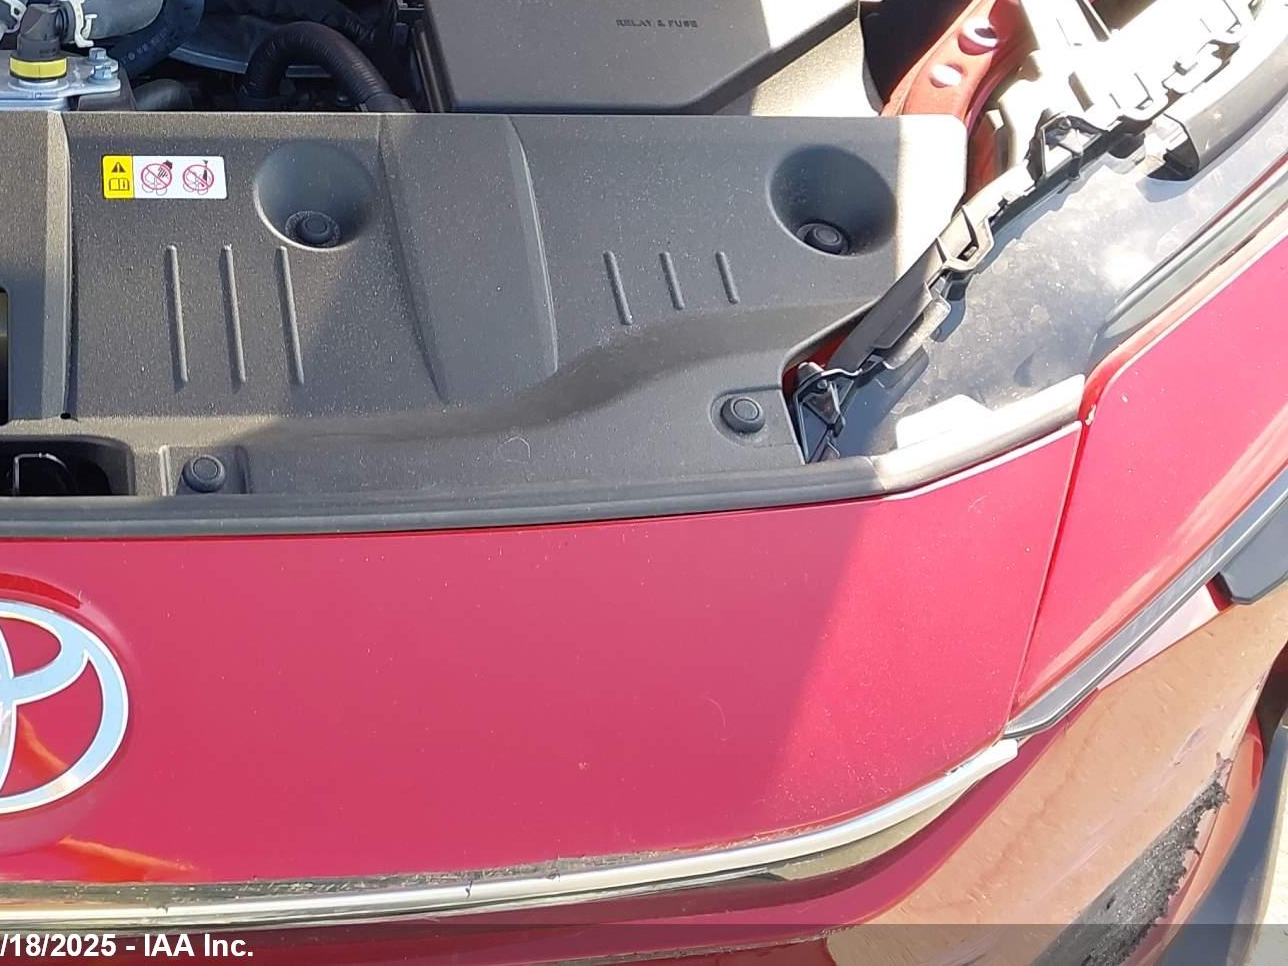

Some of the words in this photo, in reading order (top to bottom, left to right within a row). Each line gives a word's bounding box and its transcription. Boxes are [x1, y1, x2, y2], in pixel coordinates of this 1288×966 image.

[616, 19, 652, 27] RELAY
[657, 19, 666, 27] &
[668, 19, 699, 28] FUSE
